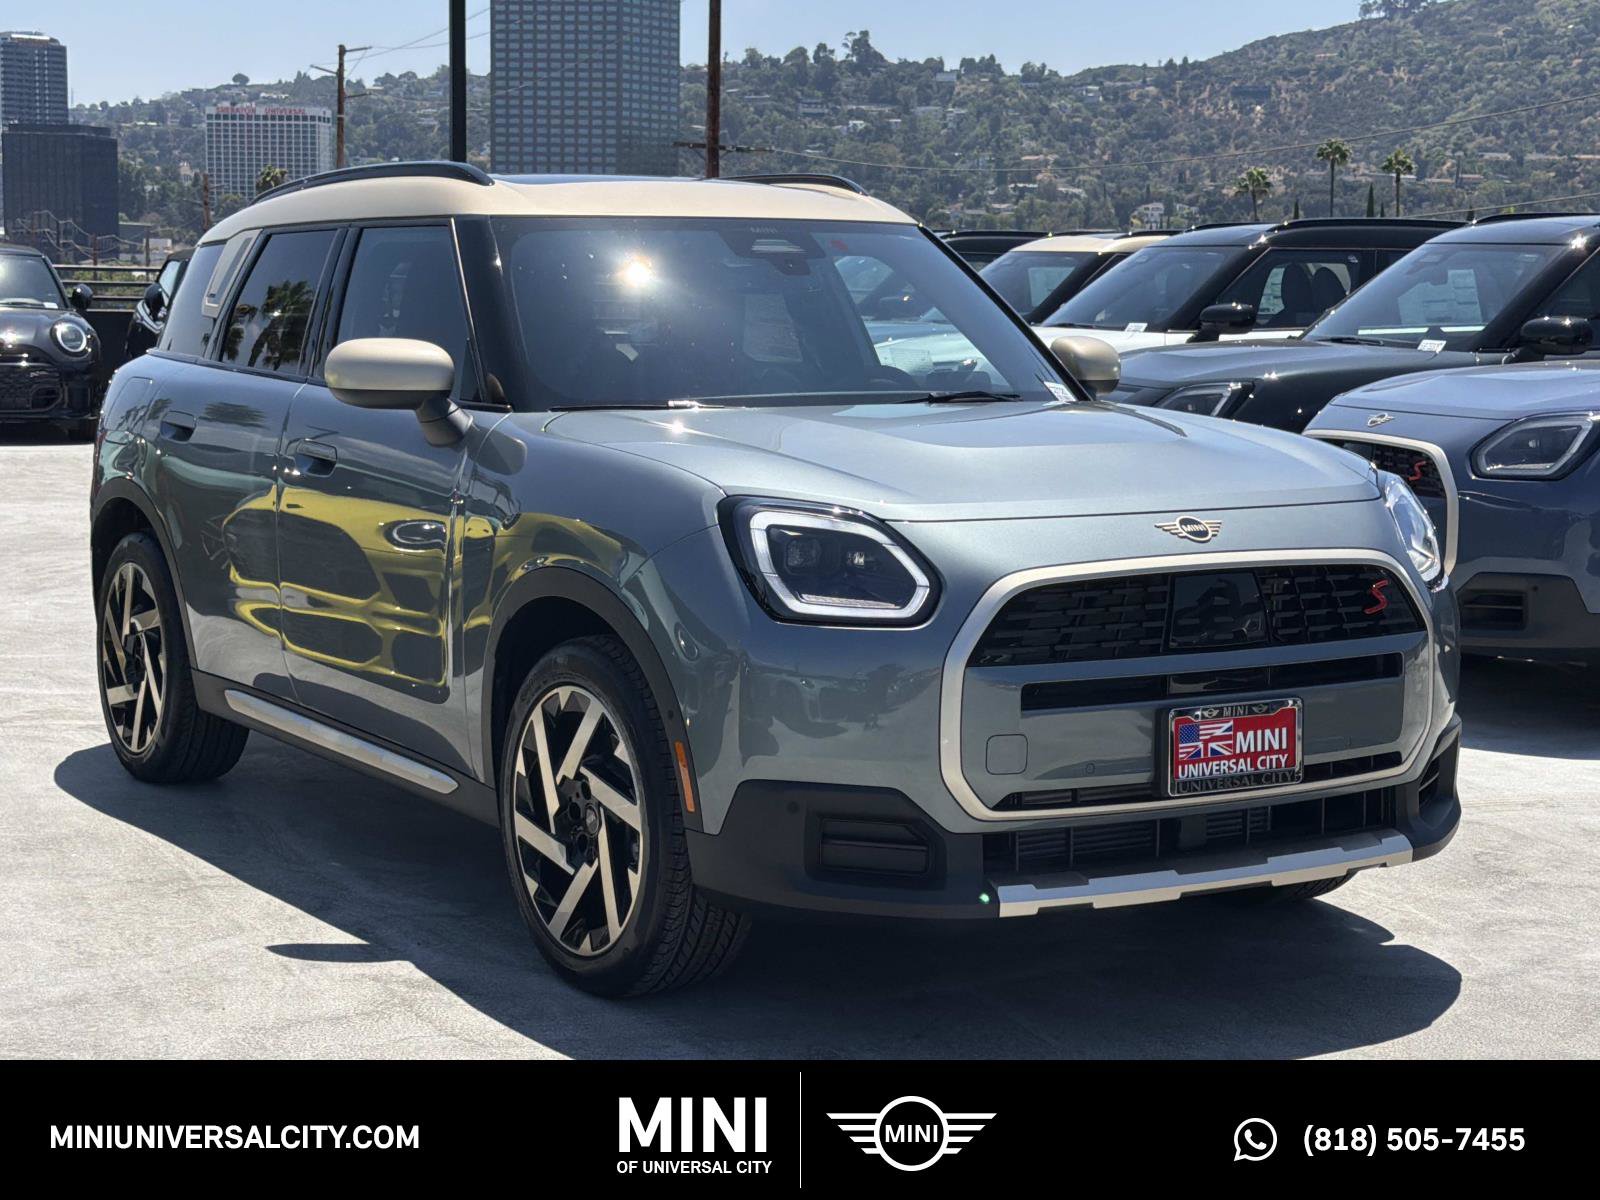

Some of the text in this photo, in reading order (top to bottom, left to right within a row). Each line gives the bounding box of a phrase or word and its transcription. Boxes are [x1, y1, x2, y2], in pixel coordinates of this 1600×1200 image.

[1181, 524, 1207, 532] MINI
[1364, 579, 1389, 615] S
[1223, 705, 1249, 717] MINI
[1235, 727, 1288, 754] MINI
[1178, 753, 1289, 779] UNIVERSAL CITY
[1178, 771, 1294, 793] UNIVERSAL CITY
